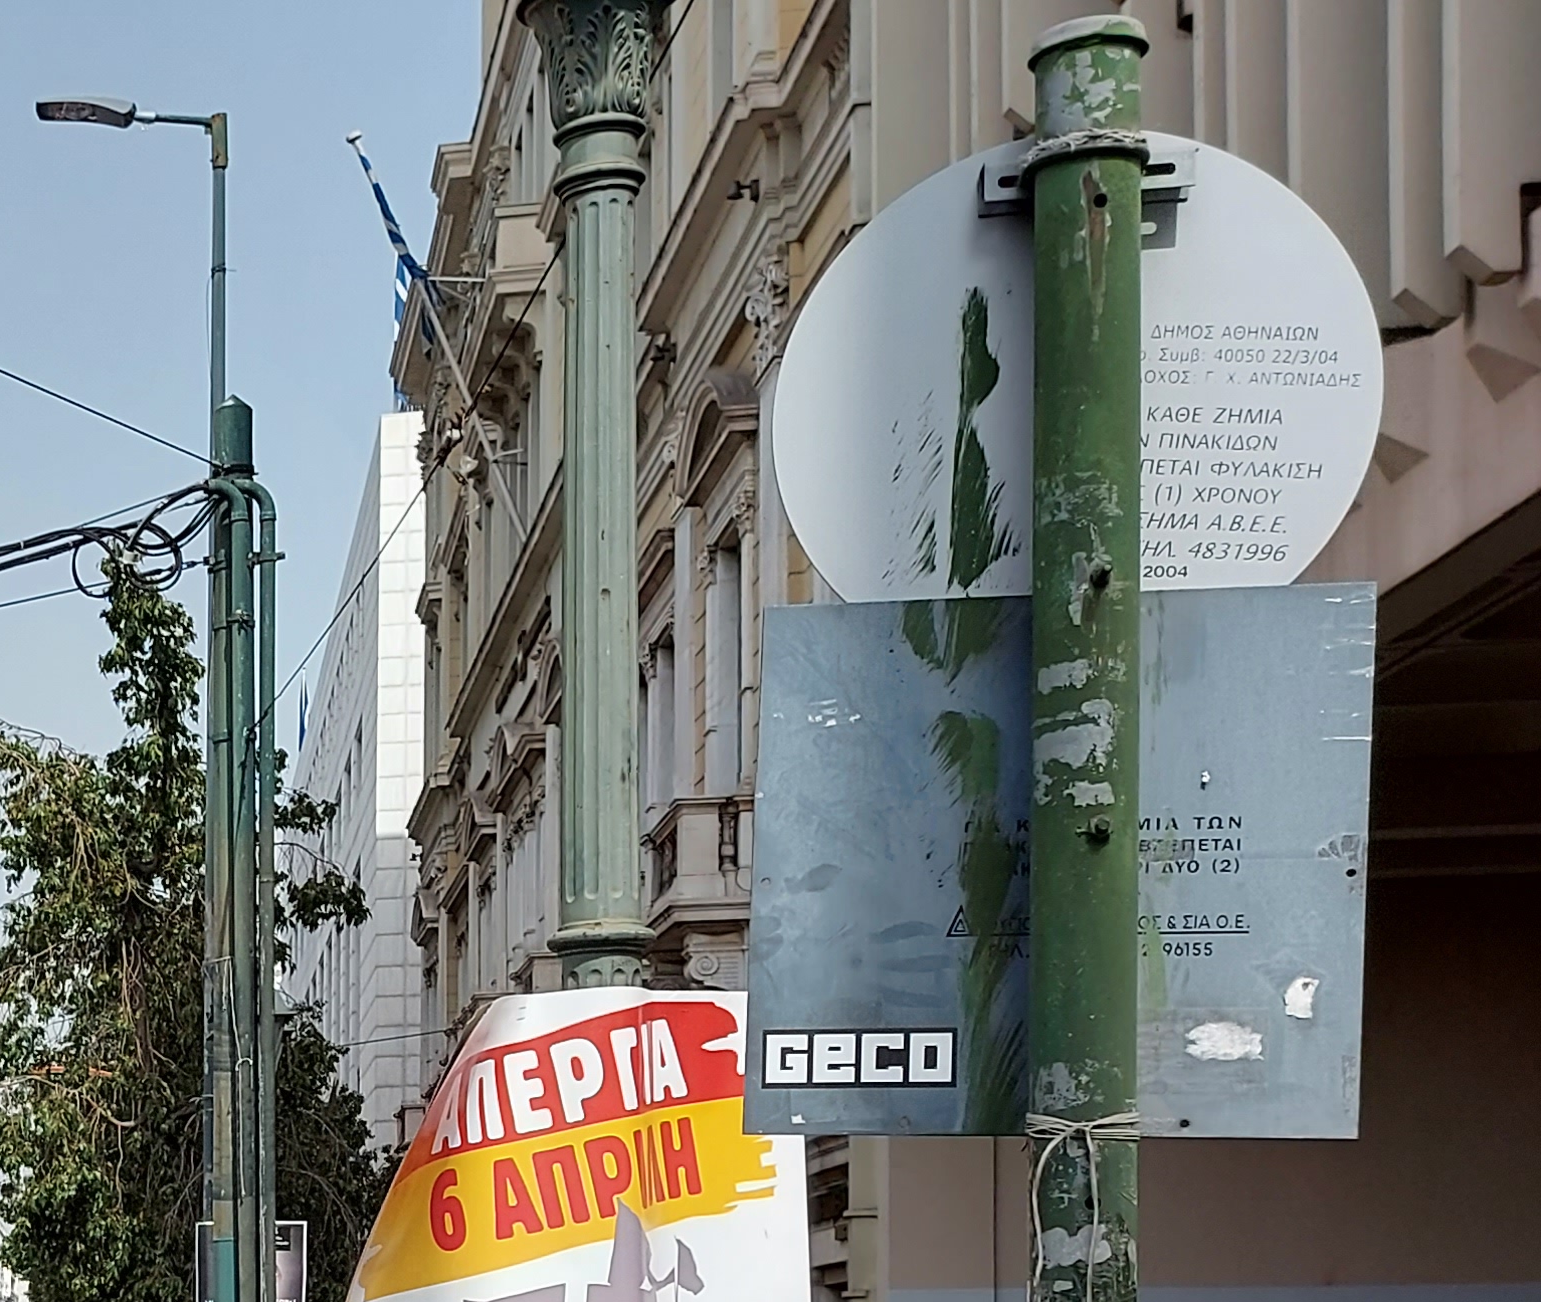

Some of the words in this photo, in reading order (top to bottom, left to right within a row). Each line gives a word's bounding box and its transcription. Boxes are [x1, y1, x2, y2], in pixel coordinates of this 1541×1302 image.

[1150, 324, 1214, 339] ΔΗΜΟΣ
[1221, 325, 1319, 341] ΑΘΗΝΑΙΩΝ
[1214, 348, 1265, 363] 40050
[1272, 349, 1339, 365] 22/3/04
[1141, 370, 1197, 385] ΟΧΟΣ:
[1248, 372, 1362, 388] ΑΝΤΩΝΙΑΔΗΣ
[1146, 406, 1203, 423] ΚΑΘΕ
[1213, 407, 1283, 425] ΖΗΜΙΑ
[1159, 433, 1278, 451] ΠΙΝΑΚΙΔΩΝ
[1140, 458, 1199, 475] ΠΕΤΑΙ
[1211, 461, 1323, 479] ΦΥΛΑΚΙΣΗ
[1155, 483, 1182, 506] (1)
[1192, 487, 1282, 504] ΧΡΟΝΟΥ
[1207, 513, 1287, 534] Α.Β.Ε.Ε.
[1188, 542, 1289, 561] 4831996
[1143, 565, 1188, 578] 2004
[1193, 816, 1242, 830] ΤΩΝ
[1212, 858, 1241, 875] (2)
[1167, 916, 1177, 930] &
[1183, 915, 1210, 929] ΣΙΑ
[1216, 914, 1250, 930] Ο.Ε.
[429, 1168, 467, 1251] 6
